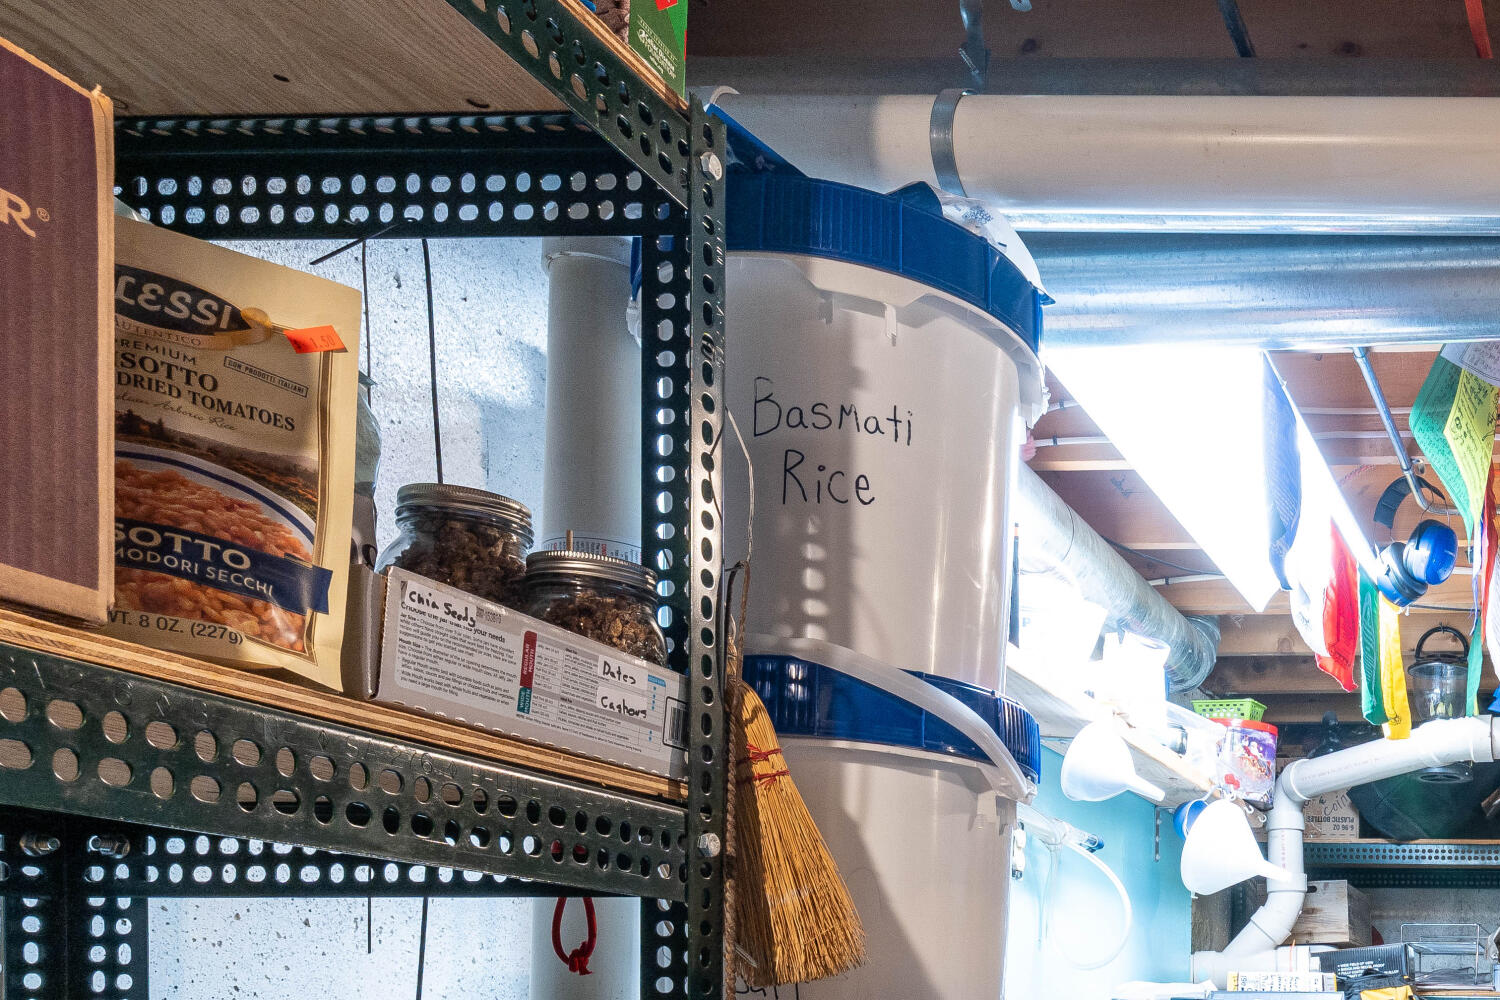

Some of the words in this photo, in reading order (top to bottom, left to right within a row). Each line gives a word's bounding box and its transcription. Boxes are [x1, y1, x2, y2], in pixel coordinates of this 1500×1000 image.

[115, 275, 232, 330] LESSI
[115, 338, 197, 366] REMIUM
[115, 352, 219, 393] SOTTO
[188, 388, 296, 432] TOMATOES
[754, 376, 912, 446] Basmati
[782, 449, 875, 506] Rice
[115, 523, 251, 571] SOTTO
[115, 547, 199, 575] ODORI
[206, 566, 274, 597] SECCHI
[408, 590, 439, 609] Chia
[139, 614, 150, 628] 8
[156, 616, 184, 634] OZ.
[190, 622, 244, 646] (227g)
